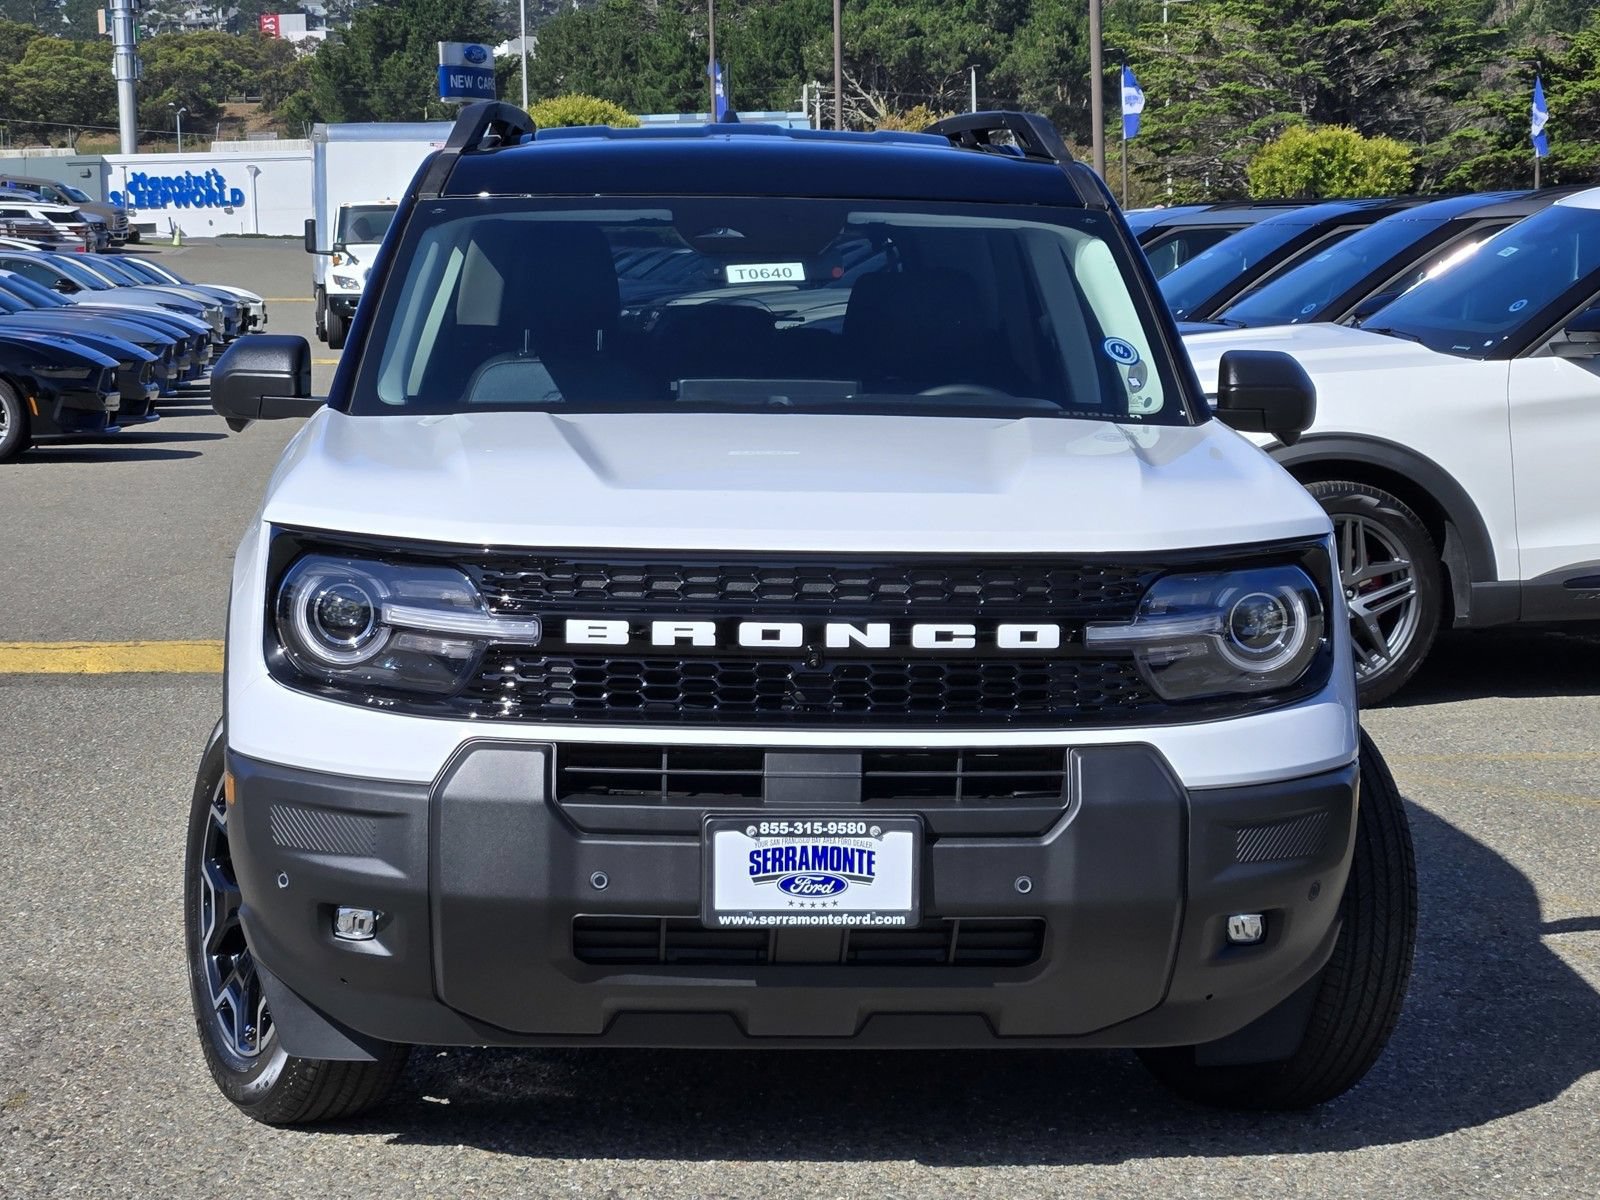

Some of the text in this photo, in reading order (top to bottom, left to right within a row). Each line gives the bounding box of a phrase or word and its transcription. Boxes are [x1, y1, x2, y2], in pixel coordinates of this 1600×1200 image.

[450, 75, 473, 88] NEW
[736, 267, 793, 280] T0640
[566, 619, 1060, 649] BRONCO
[759, 822, 867, 835] 855-315-9580
[770, 838, 781, 847] SAN
[838, 837, 852, 846] FORD
[853, 839, 873, 849] DEALER
[749, 846, 876, 876] SERRAMONTE
[789, 875, 835, 894] Ford
[718, 913, 906, 925] www.serramonteford.com
